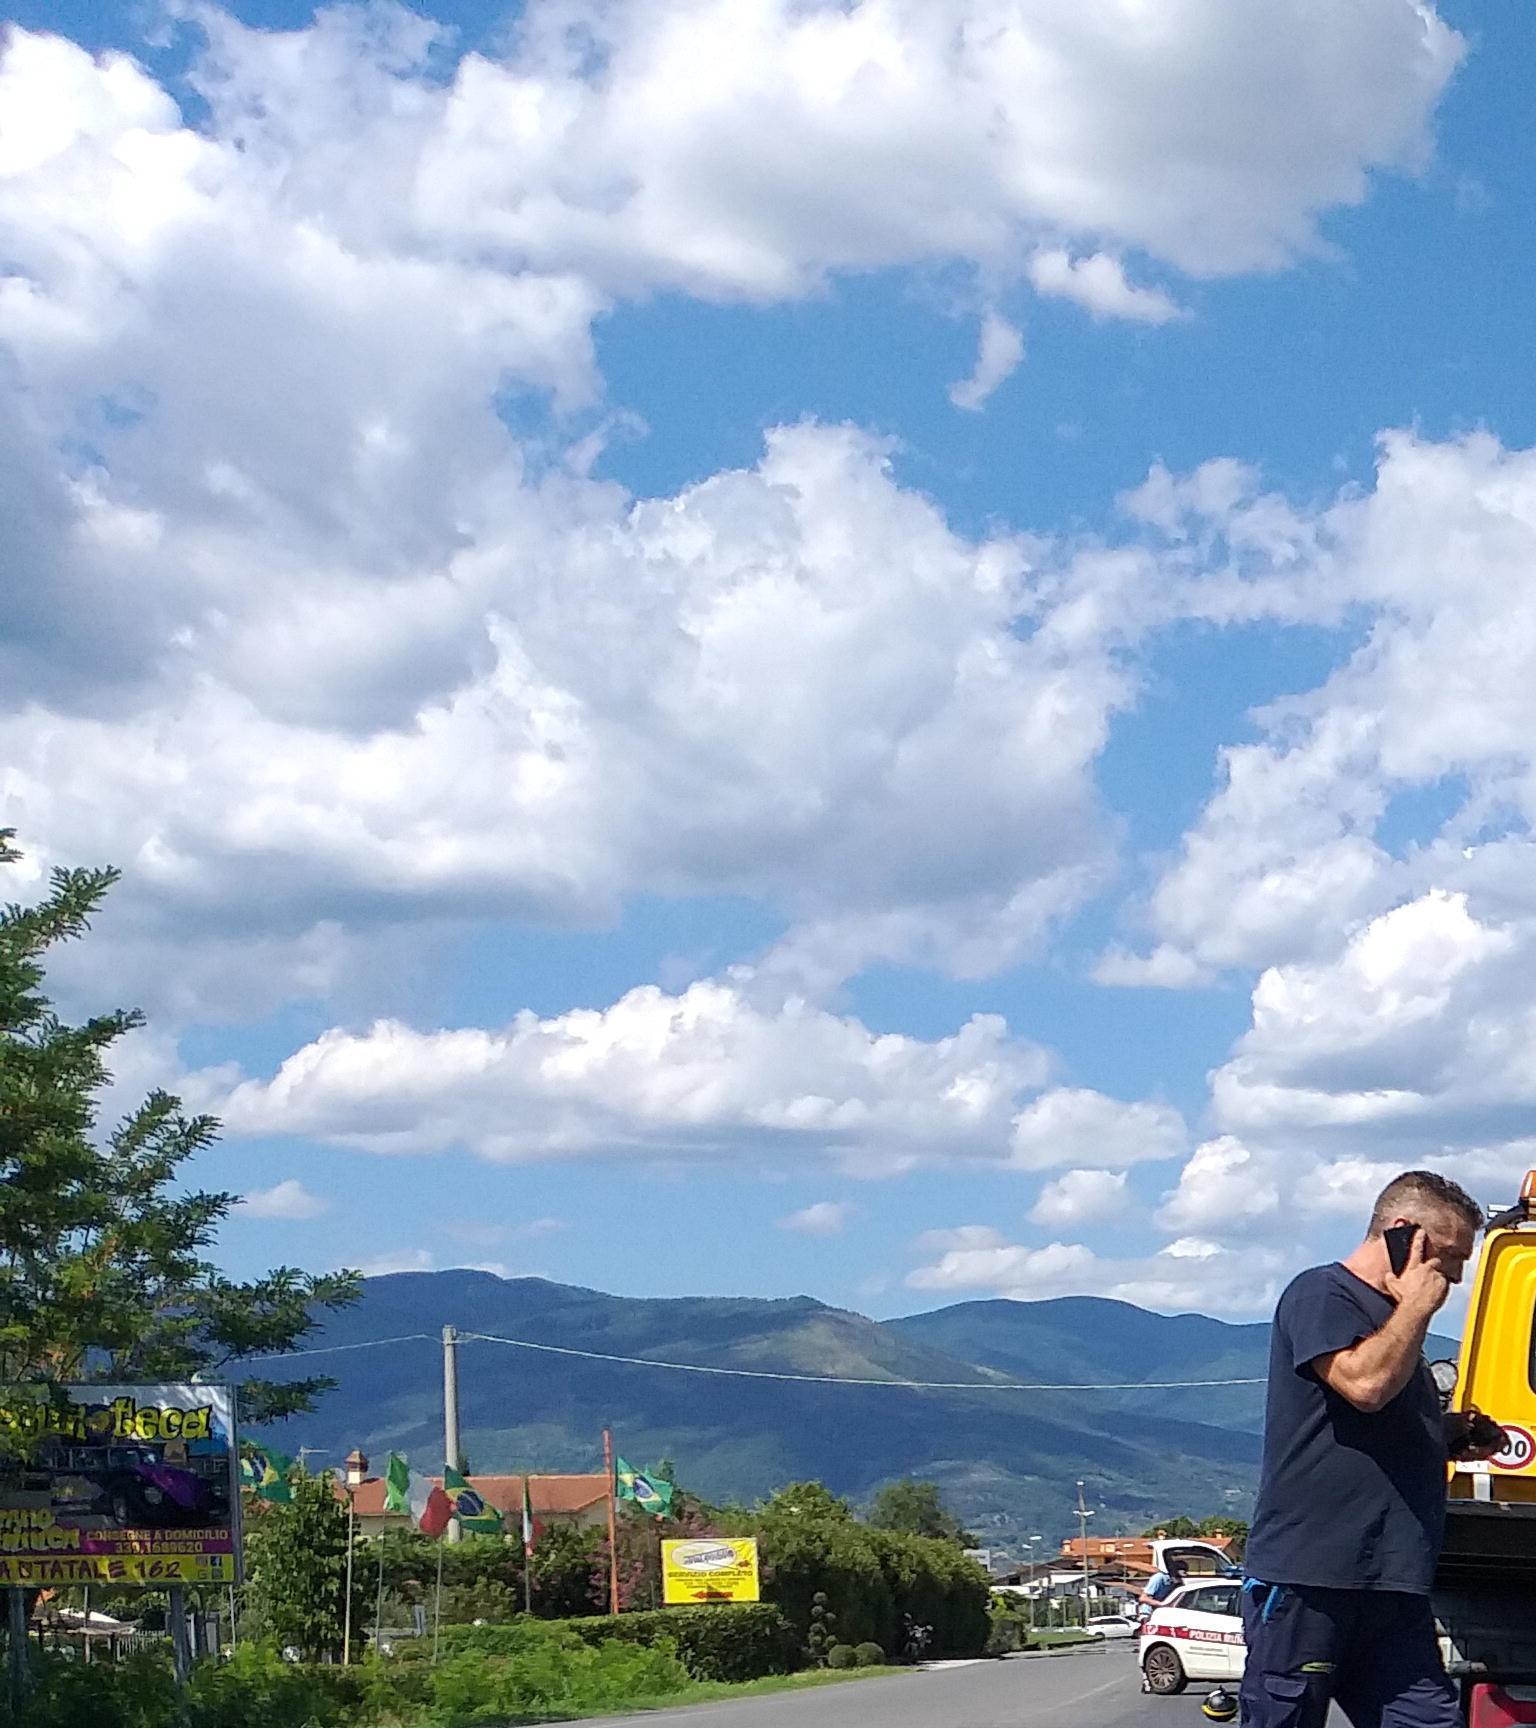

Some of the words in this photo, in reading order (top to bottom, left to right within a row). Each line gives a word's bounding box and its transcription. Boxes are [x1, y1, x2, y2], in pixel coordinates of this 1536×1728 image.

[153, 1529, 162, 1541] A
[165, 1529, 228, 1540] DOMICILIO
[135, 1560, 182, 1578] 162
